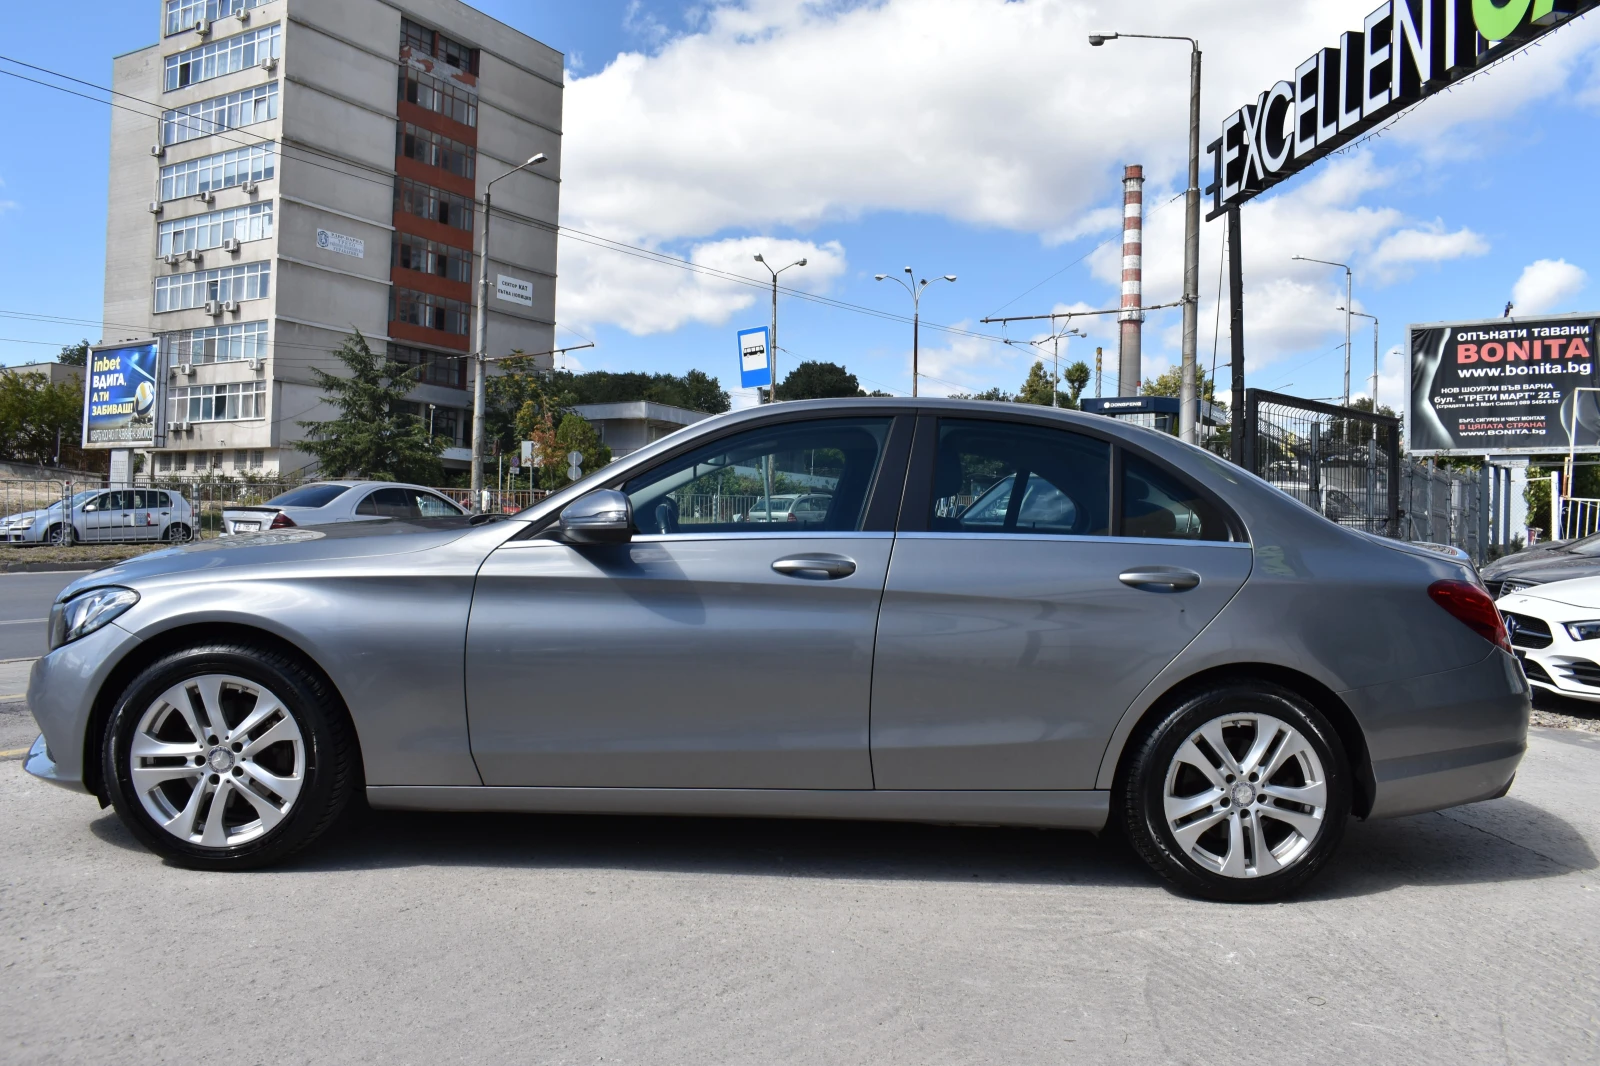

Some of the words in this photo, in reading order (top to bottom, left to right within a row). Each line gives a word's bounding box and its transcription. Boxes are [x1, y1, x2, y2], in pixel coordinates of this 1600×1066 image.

[1457, 329, 1527, 341] опънати
[1532, 325, 1589, 337] тавани
[1457, 338, 1590, 364] BONITA
[94, 356, 121, 372] inbet
[1458, 362, 1591, 378] www.bonita.bg
[93, 373, 127, 389] ВДИГА,
[1461, 385, 1499, 393] ШОУРУМ
[92, 392, 98, 402] А
[99, 391, 109, 402] ТИ
[1434, 396, 1456, 404] бул.
[1538, 391, 1550, 399] 22
[92, 403, 133, 416] ЗАБИВАШ!
[1460, 428, 1546, 436] www.BONITA.bg
